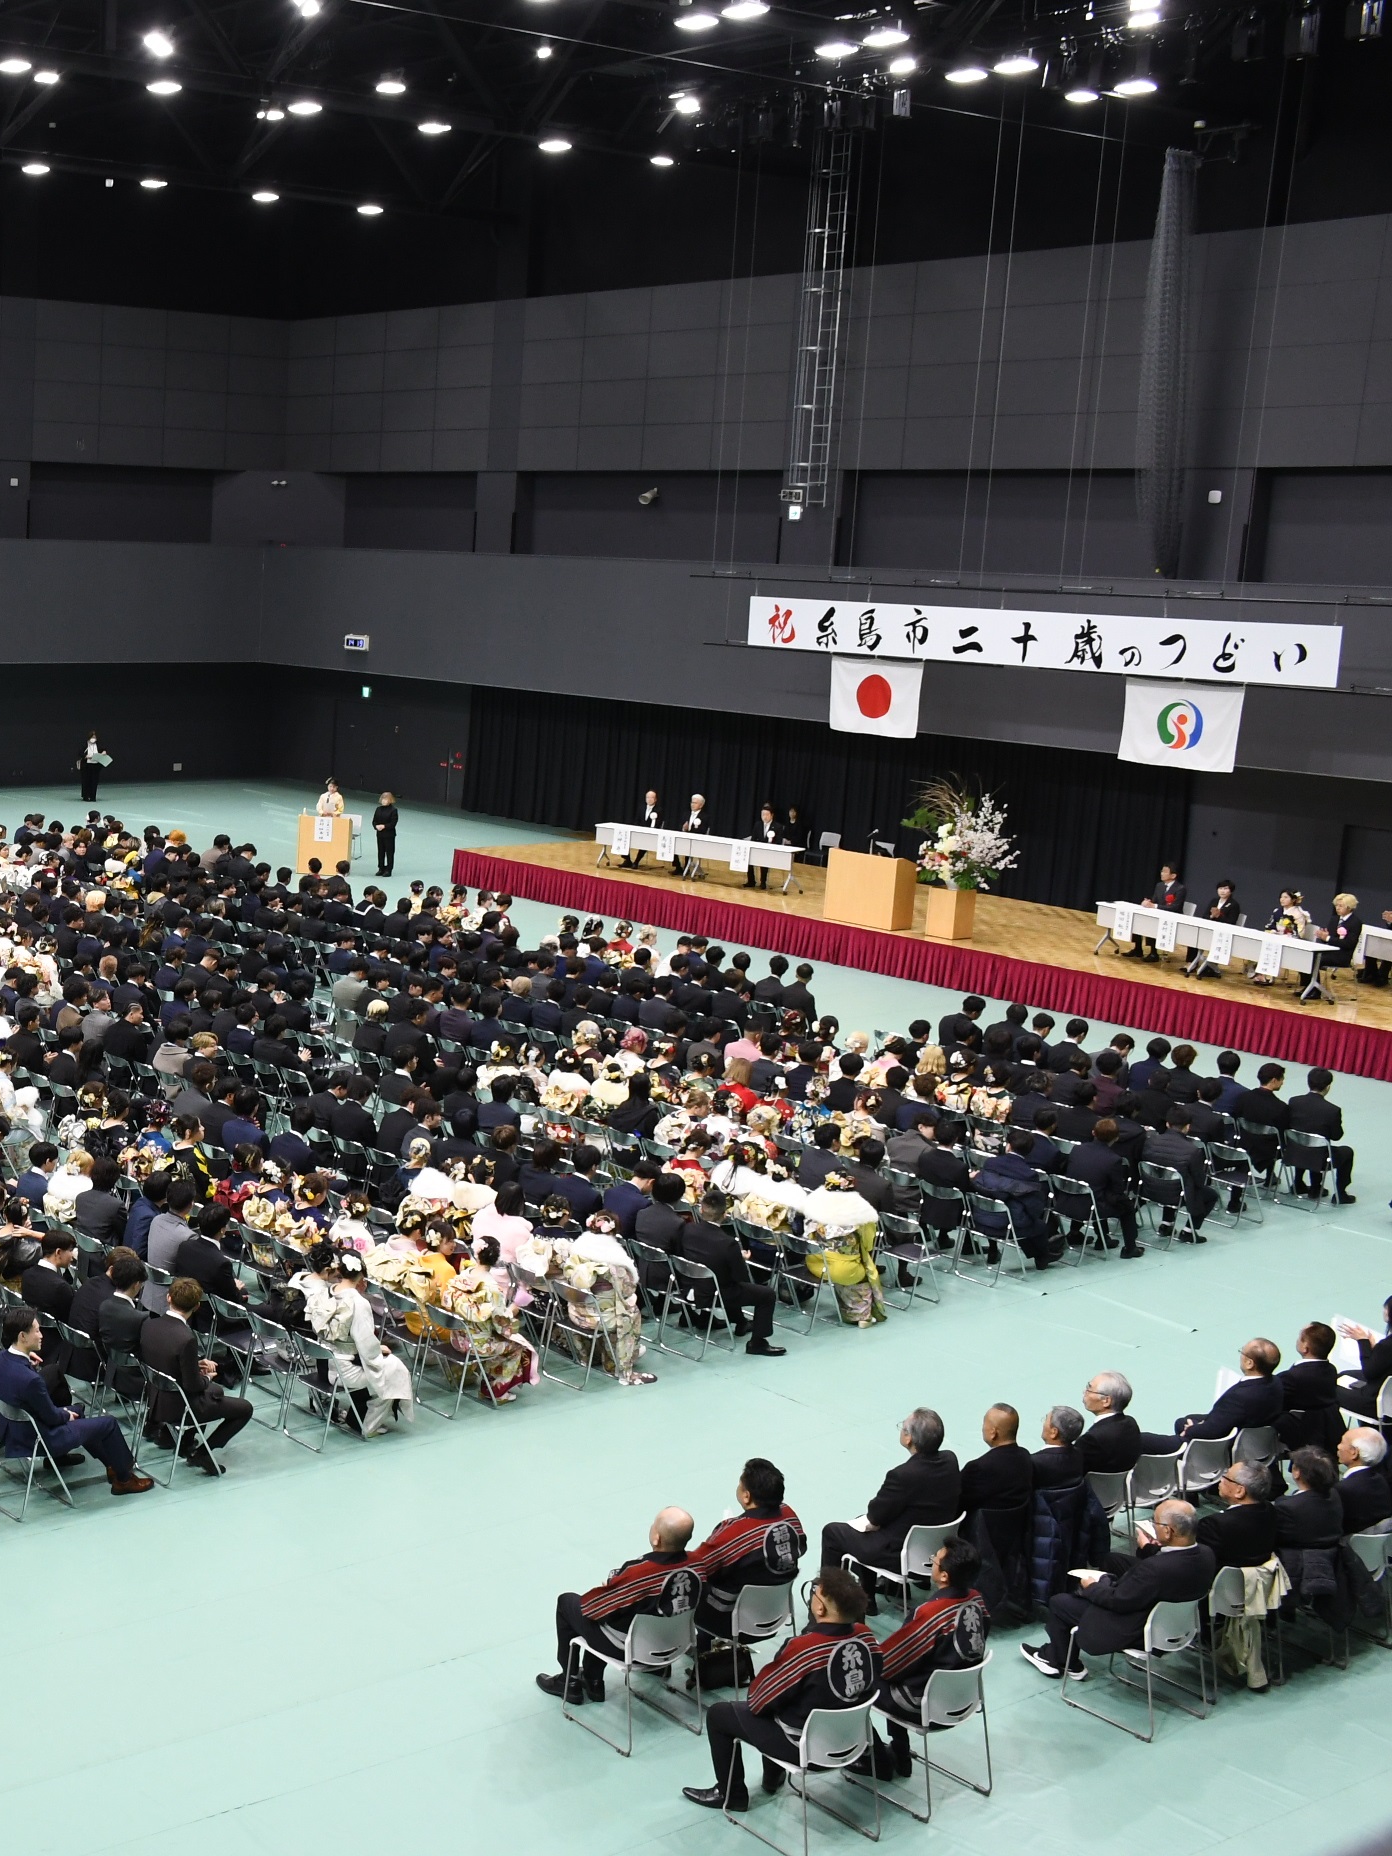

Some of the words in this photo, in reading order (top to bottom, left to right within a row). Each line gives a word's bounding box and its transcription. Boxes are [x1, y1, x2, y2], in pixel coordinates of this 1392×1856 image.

[772, 1524, 795, 1571] 福岡県
[670, 1571, 692, 1616] 糸島
[841, 1643, 866, 1698] 糸島
